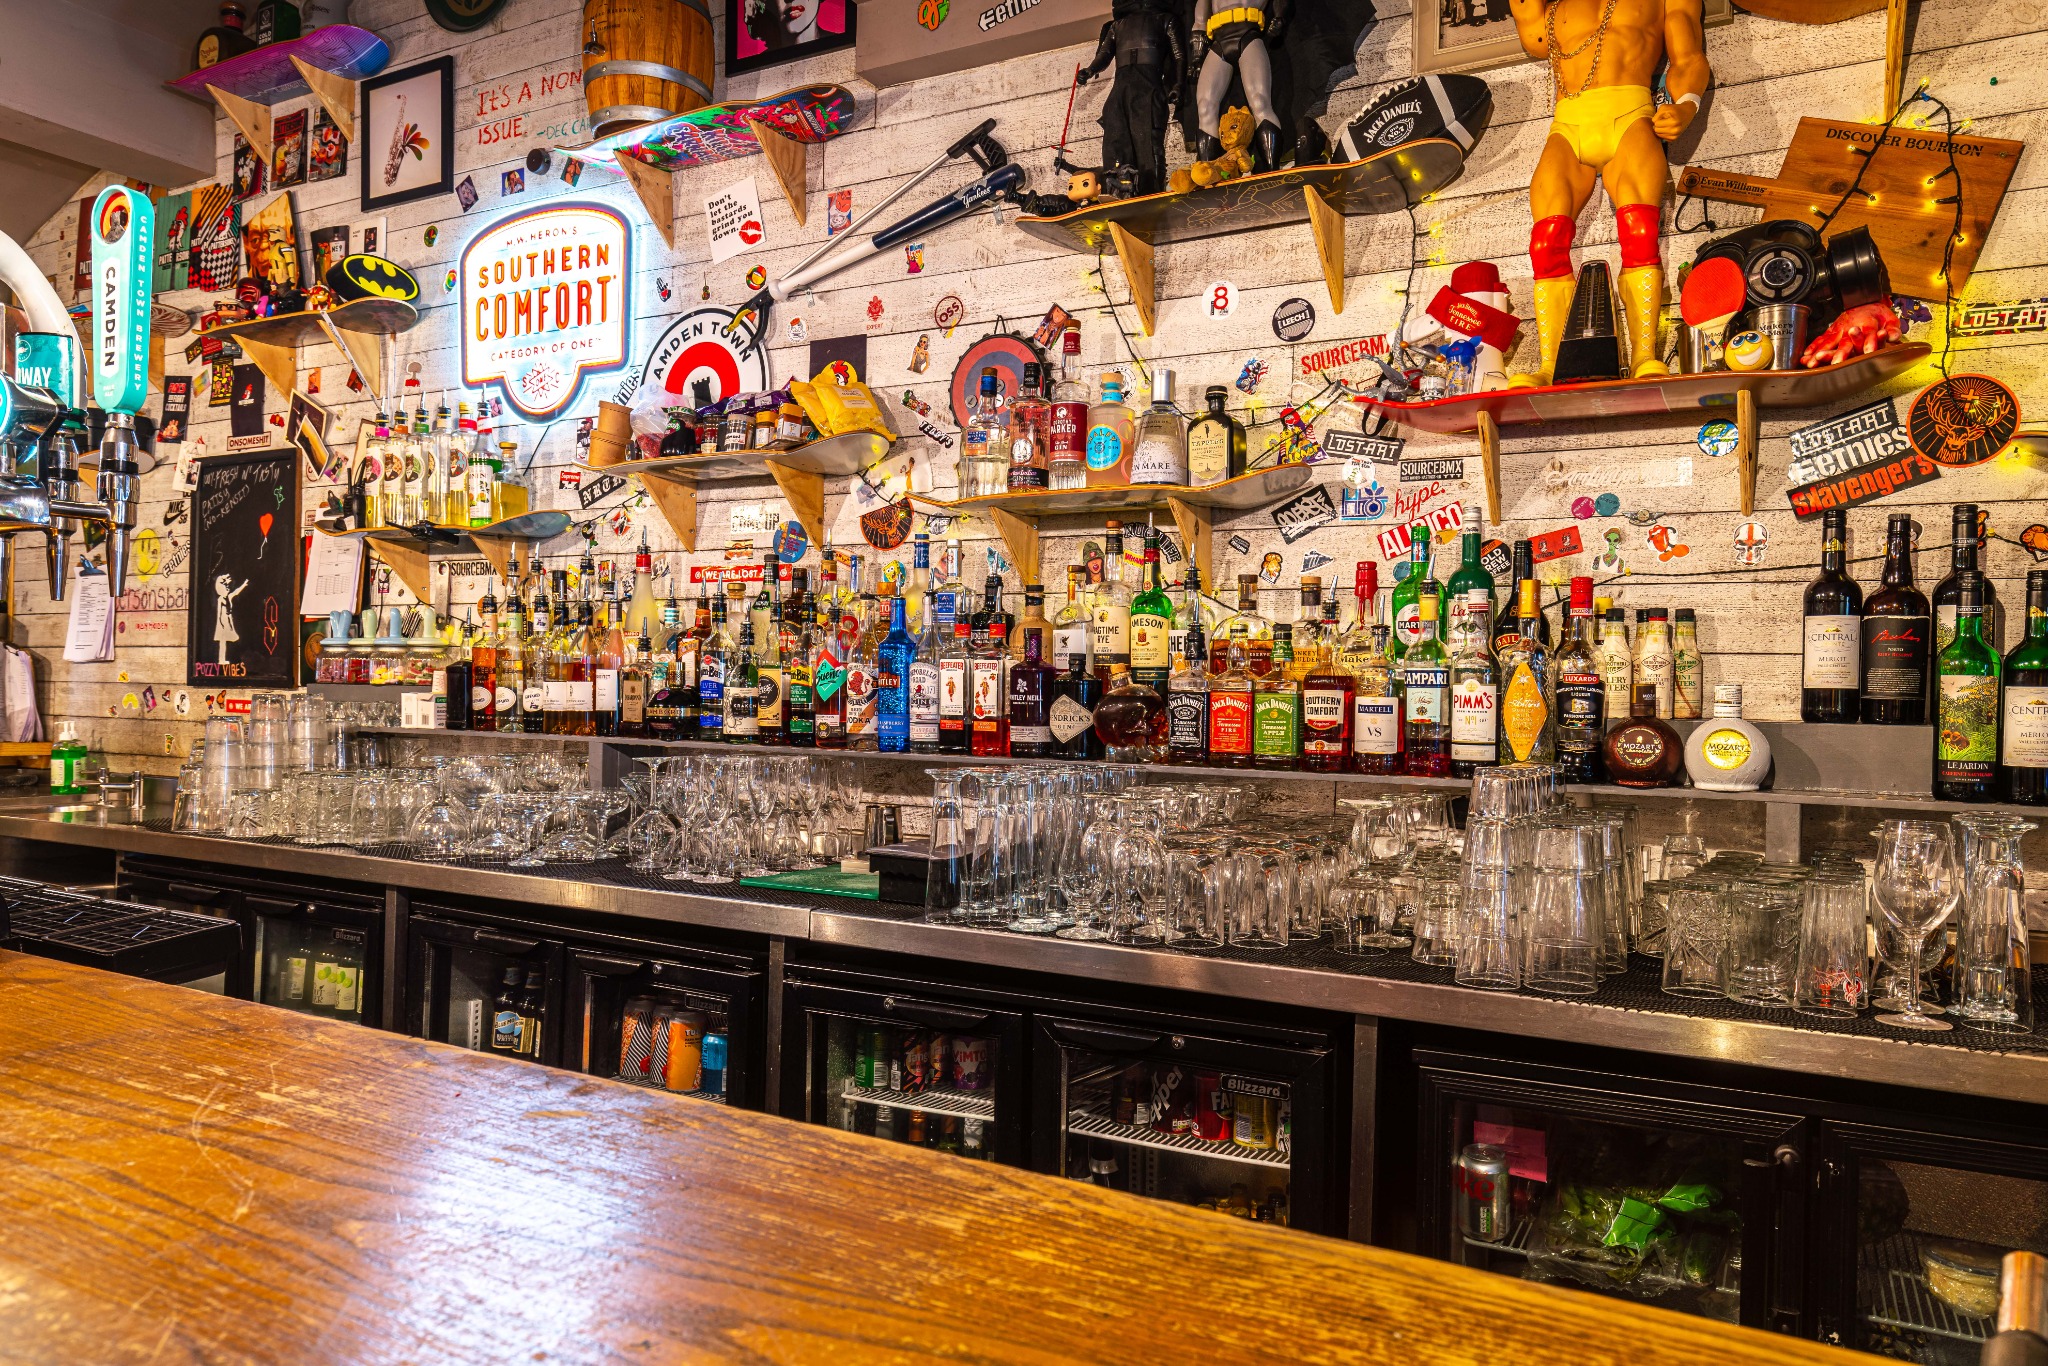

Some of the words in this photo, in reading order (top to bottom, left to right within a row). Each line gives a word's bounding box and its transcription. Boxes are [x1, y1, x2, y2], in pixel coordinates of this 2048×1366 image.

[518, 81, 532, 104] A
[1363, 118, 1383, 144] JACK
[1381, 99, 1423, 124] DANIEL'S
[1826, 127, 1902, 148] DISCOVER
[1905, 136, 1985, 158] BOURBON
[1700, 176, 1725, 189] Evan
[1725, 179, 1765, 194] Williams
[708, 193, 732, 210] Don't
[961, 185, 993, 208] Yankees
[710, 208, 723, 219] let
[723, 199, 738, 214] the
[711, 203, 748, 226] bastards
[711, 217, 735, 236] grind
[737, 209, 754, 223] you
[712, 227, 740, 243] down.
[138, 215, 148, 273] CAMDEN
[478, 244, 610, 289] SOUTHERN
[136, 280, 146, 317] TOWN
[1213, 286, 1229, 310] 8
[475, 275, 612, 342] COMFORT
[939, 301, 960, 323] OSS
[104, 266, 117, 367] CAMDEN
[1283, 313, 1305, 329] LEECH
[1448, 305, 1482, 328] Tennessee
[1450, 315, 1472, 332] FIRE
[1759, 321, 1794, 332] Maker's
[1770, 328, 1794, 337] Mark
[133, 325, 144, 391] BREWERY
[490, 346, 546, 362] CATEGORY
[551, 342, 565, 353] OF
[653, 321, 703, 381] AMDEN
[711, 321, 752, 363] TOWN
[612, 366, 641, 407] tnies
[1050, 423, 1077, 434] PARKER
[229, 435, 269, 448] ONSOMESHIT
[1401, 460, 1463, 476] SOURCEBMX
[561, 473, 581, 482] Supreme
[170, 501, 185, 514] NIKE
[1481, 548, 1502, 565] OLD
[1485, 553, 1506, 571] REW
[738, 569, 758, 579] LOST
[1489, 560, 1511, 577] OFFEE
[1094, 626, 1120, 635] RAGTIME
[1811, 632, 1855, 642] CENTRAL
[1097, 635, 1110, 644] RYE
[1497, 635, 1519, 649] BAIL
[1293, 649, 1317, 657] ONKEY
[1340, 655, 1370, 664] Make
[222, 662, 247, 678] VIBES
[940, 661, 964, 671] BEEFEATER
[974, 661, 998, 671] BEEFEATER
[702, 682, 718, 690] LVER
[1404, 672, 1448, 685] CAMPARI
[1564, 675, 1598, 683] LUXARDO
[1606, 677, 1627, 685] LERY
[1169, 697, 1184, 710] JACK
[1184, 696, 1205, 710] DANIEL'S
[1211, 699, 1225, 712] JACK
[1225, 697, 1250, 712] DANIEL'S
[1256, 699, 1270, 713] JACK
[1270, 698, 1295, 713] DANIEL'S
[1306, 696, 1341, 706] SOUTHERN
[1453, 691, 1494, 710] PIMM'S
[1307, 706, 1339, 716] COMFORT
[1359, 705, 1392, 713] MARTELL
[1217, 721, 1241, 729] Tennessee
[1261, 723, 1287, 731] Tennessee
[1367, 727, 1382, 737] VS
[1622, 742, 1655, 750] MOZART
[1707, 742, 1747, 751] MOZART
[1947, 760, 1957, 770] LE
[1957, 761, 1989, 771] JARDIN
[335, 931, 361, 943] Blizzard
[689, 998, 723, 1012] Blizzard
[1227, 1078, 1281, 1097] Blizzard
